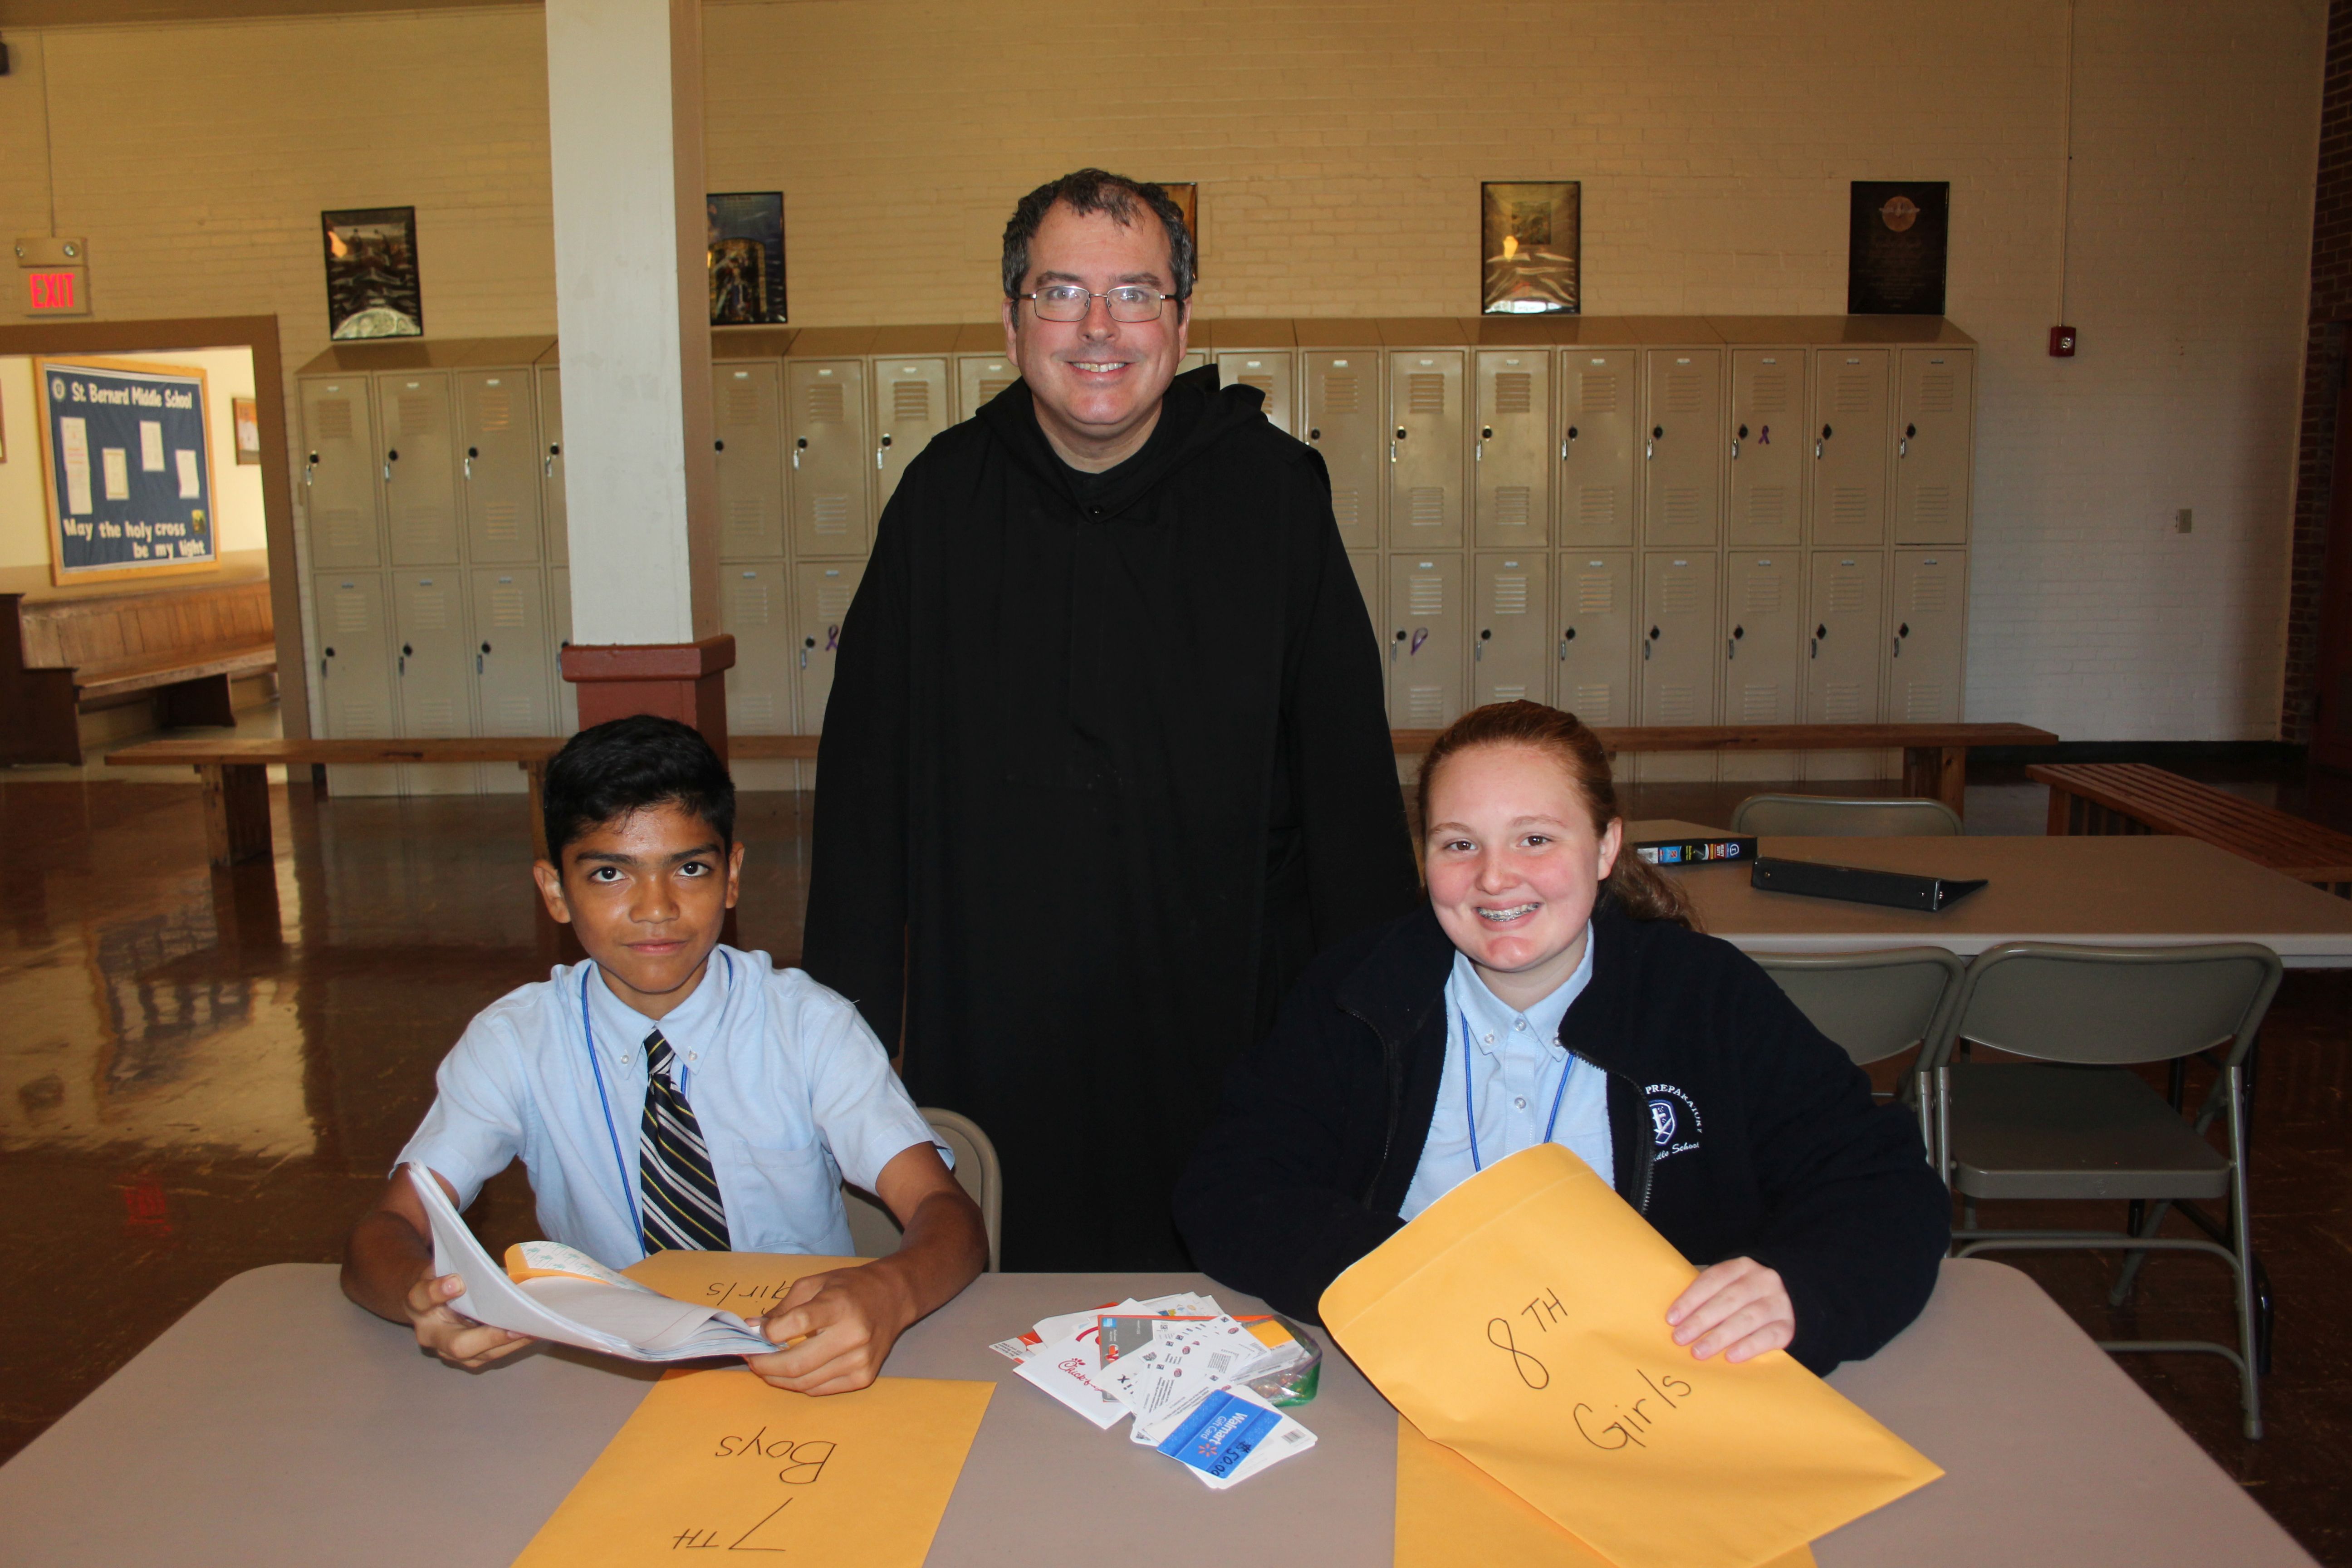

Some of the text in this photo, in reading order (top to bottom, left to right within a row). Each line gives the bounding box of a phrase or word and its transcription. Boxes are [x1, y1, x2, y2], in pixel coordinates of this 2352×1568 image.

[30, 273, 75, 308] EXIT
[72, 382, 192, 409] St. Bernard Middle School
[63, 519, 186, 542] May the holy cross
[132, 540, 206, 559] be my light
[1672, 1142, 1700, 1154] School
[1573, 1368, 1691, 1450] Girls
[1200, 1416, 1227, 1440] Gift Card
[1209, 1412, 1248, 1445] Walmart
[715, 1426, 837, 1484] Boys
